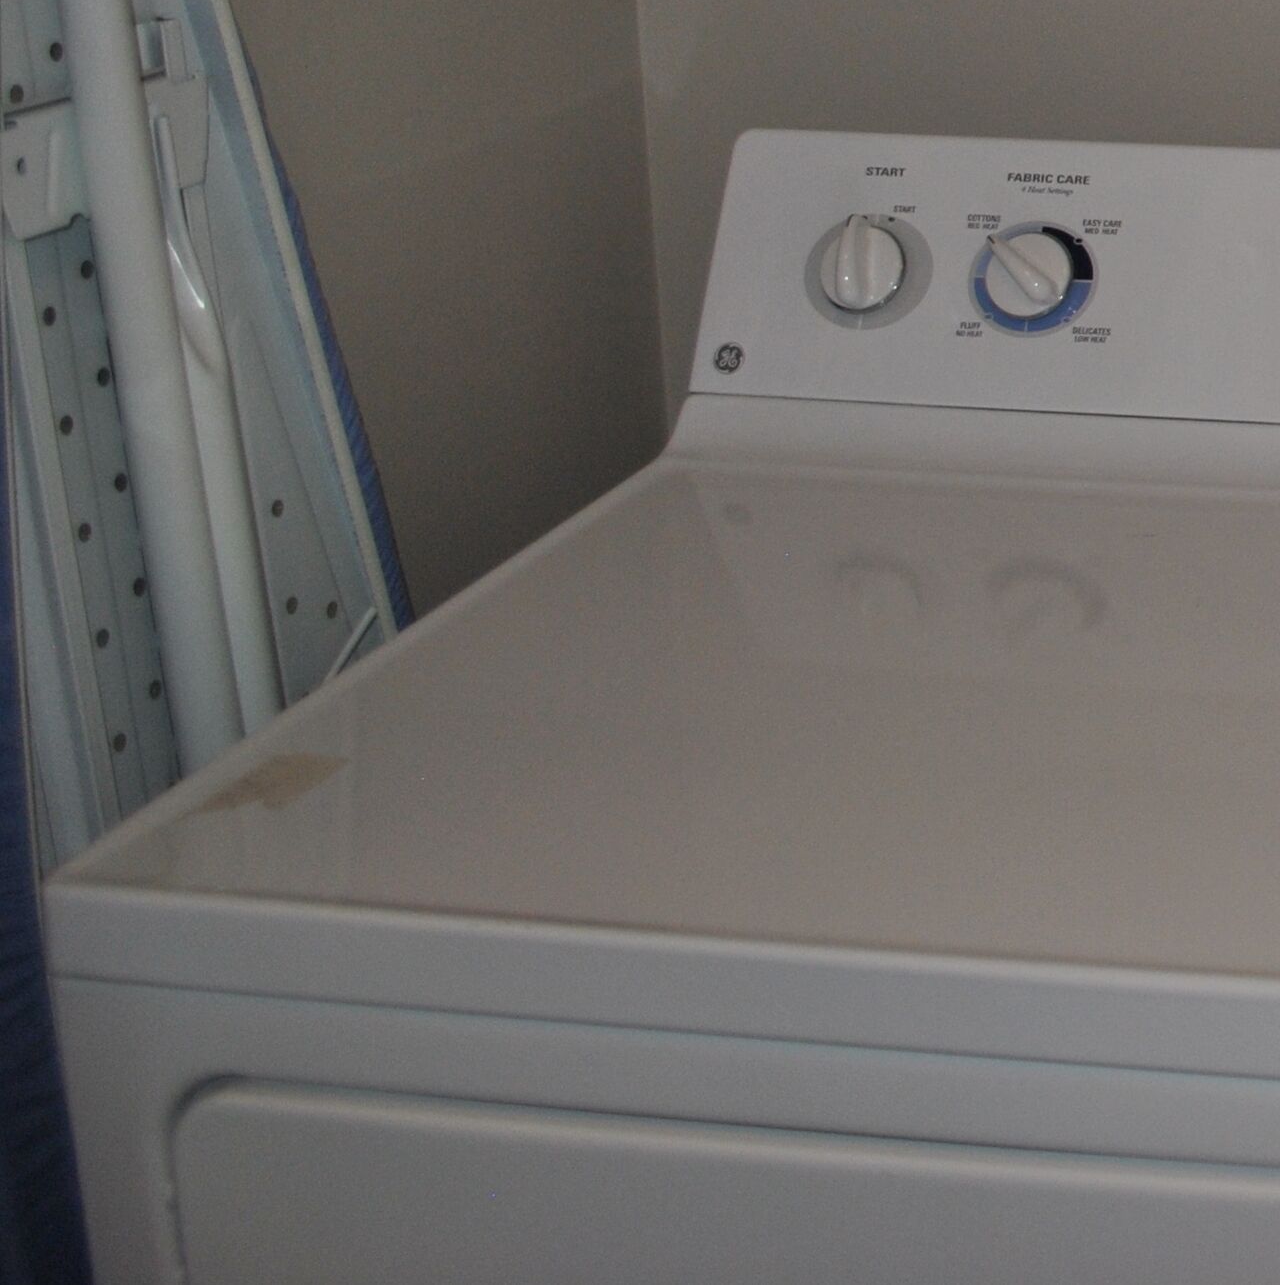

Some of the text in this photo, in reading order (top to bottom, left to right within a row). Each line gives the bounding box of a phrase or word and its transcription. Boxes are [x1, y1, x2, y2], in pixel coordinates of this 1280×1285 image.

[866, 166, 906, 177] START
[1007, 172, 1090, 185] FABRIC CARE
[1048, 187, 1074, 196] Settings
[893, 205, 916, 213] START
[967, 214, 1001, 223] COTTONS
[1082, 219, 1122, 228] EASY CARE
[1072, 327, 1111, 336] DELICATES
